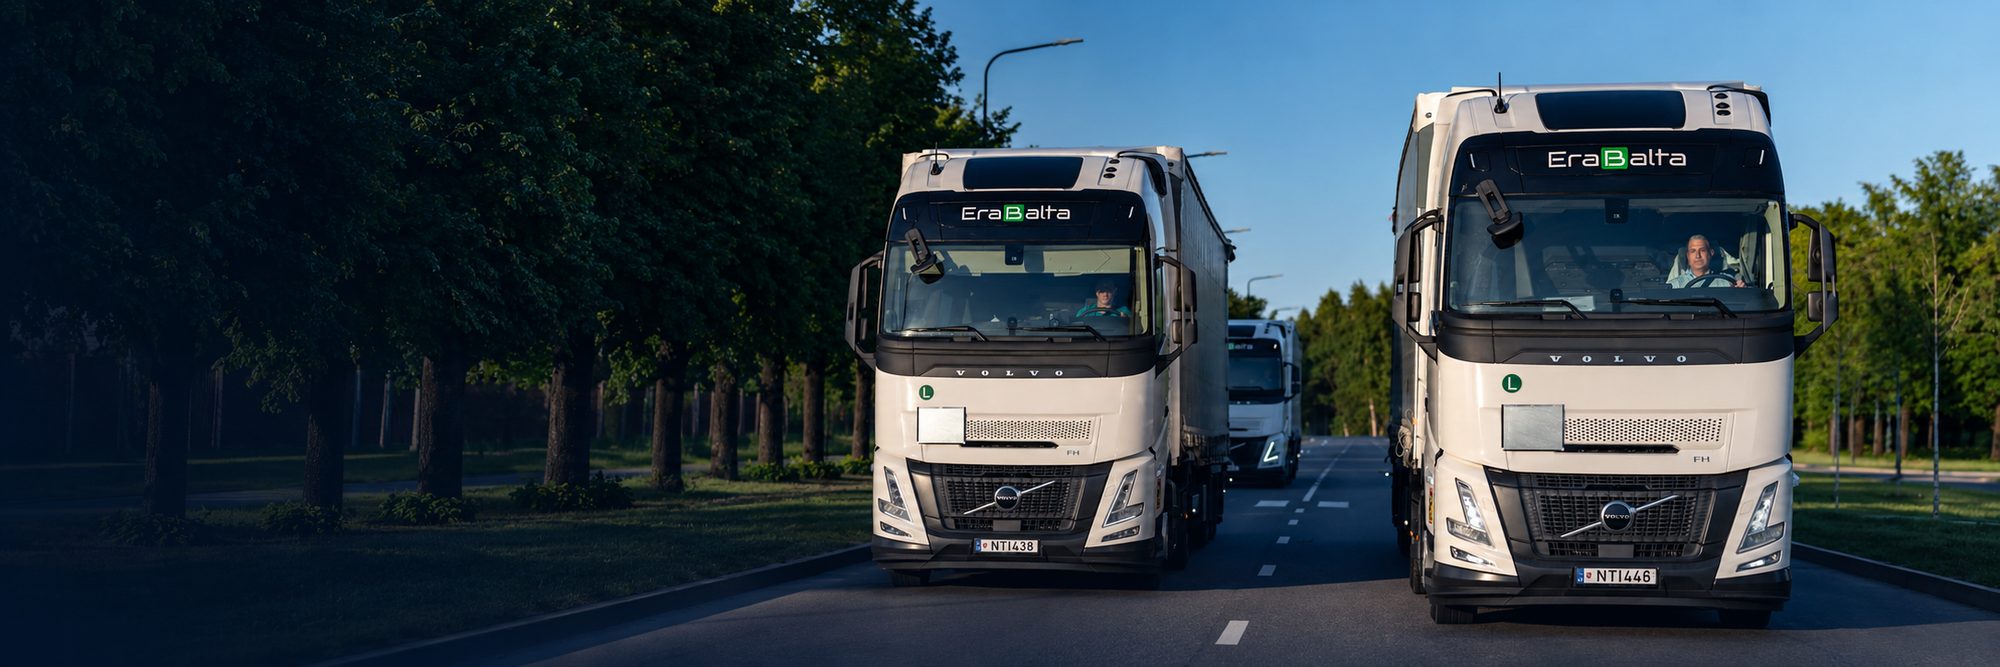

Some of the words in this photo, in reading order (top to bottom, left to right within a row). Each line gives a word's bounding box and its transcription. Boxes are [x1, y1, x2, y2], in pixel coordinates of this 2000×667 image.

[1548, 148, 1687, 168] EraBalta
[961, 205, 1071, 220] EraBalta
[1550, 355, 1687, 363] VOLVO
[1507, 376, 1518, 391] L
[922, 387, 930, 398] L
[991, 541, 1034, 551] NTI438
[1596, 570, 1651, 583] NTI446
